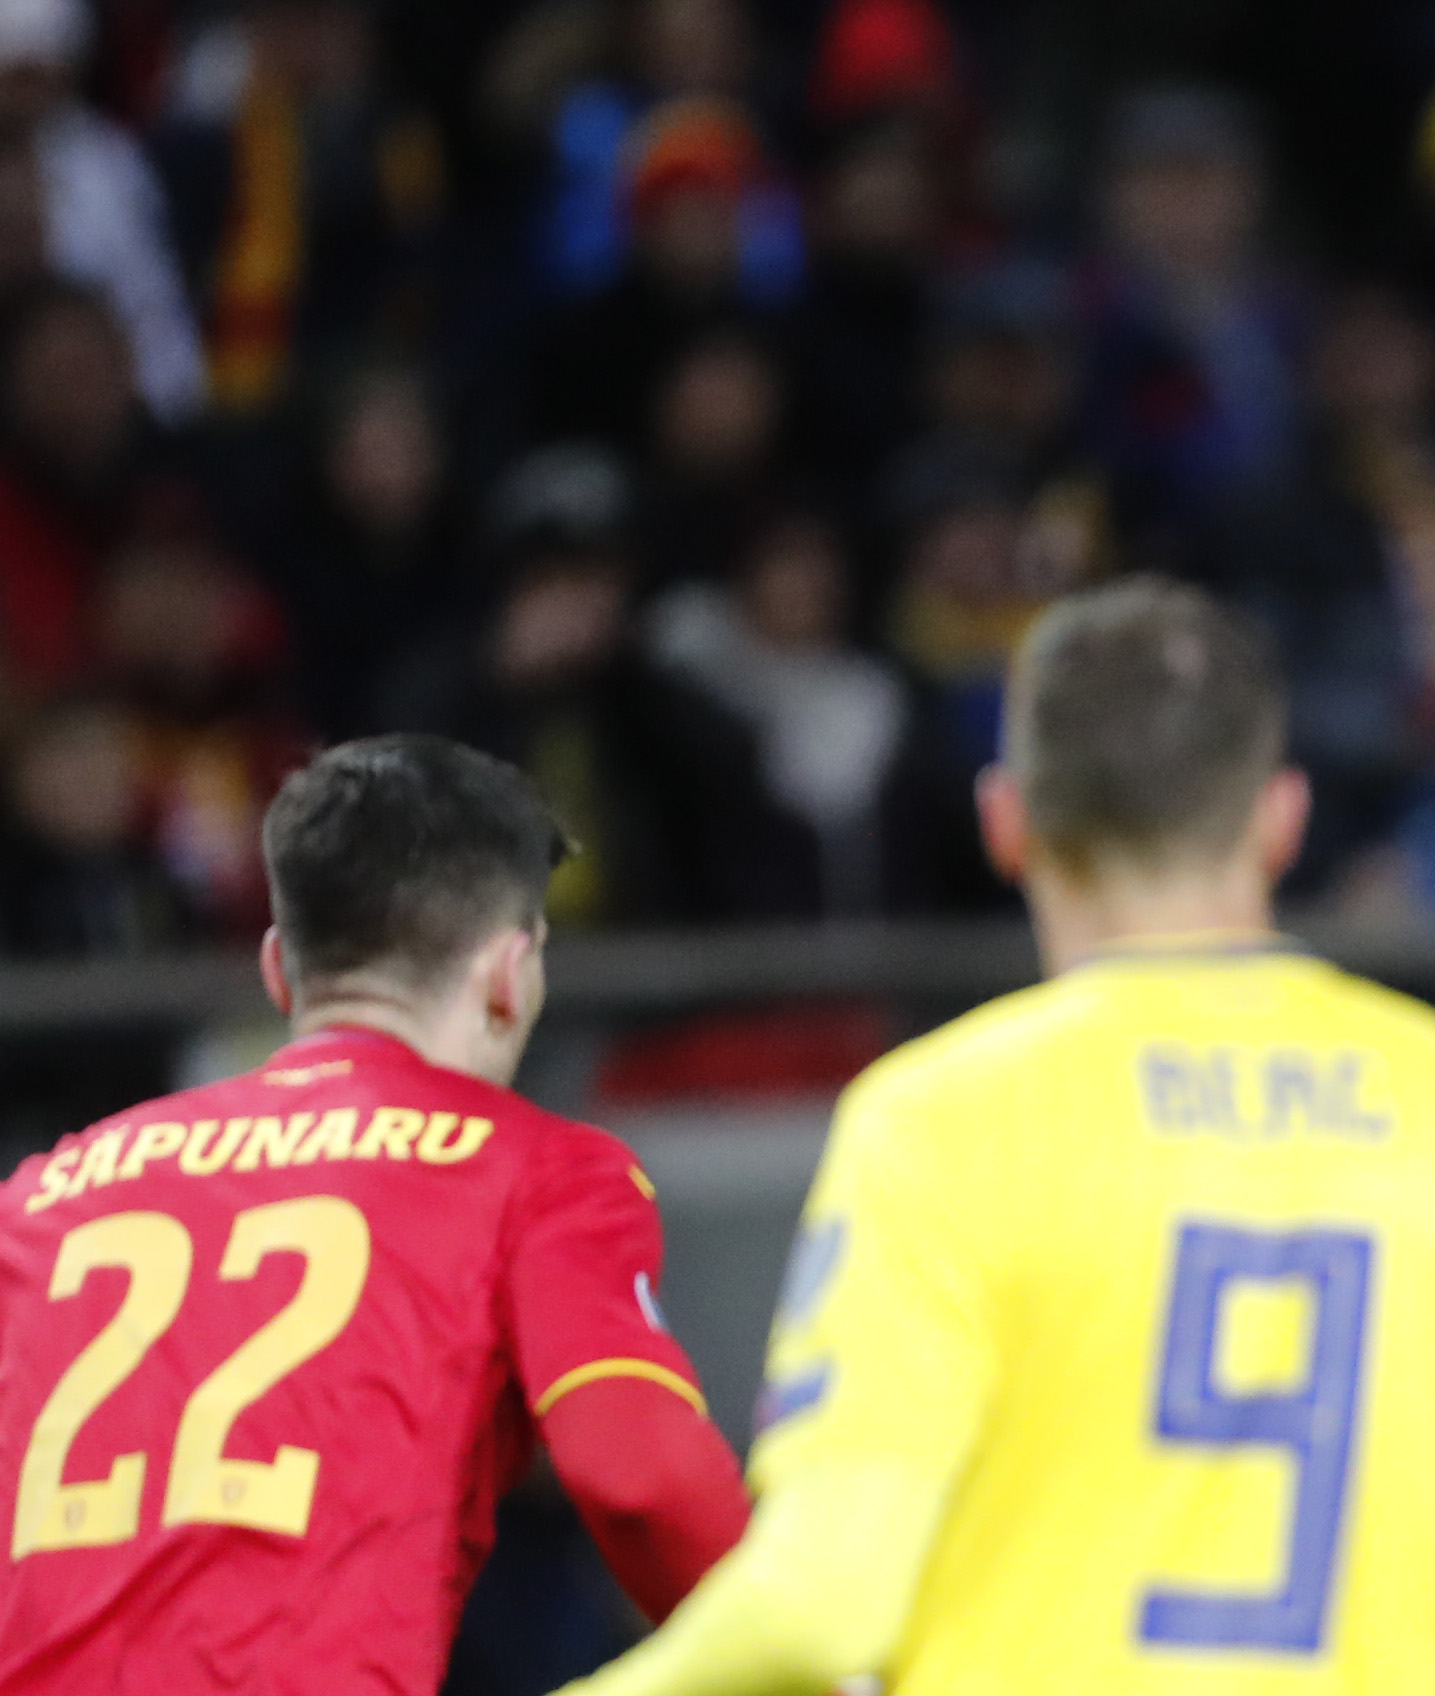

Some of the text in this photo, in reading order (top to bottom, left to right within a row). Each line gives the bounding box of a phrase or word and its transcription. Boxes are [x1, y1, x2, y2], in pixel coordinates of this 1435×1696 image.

[24, 1106, 496, 1216] SAPUNARU
[12, 1193, 371, 1562] 22
[1137, 1220, 1376, 1656] 9
